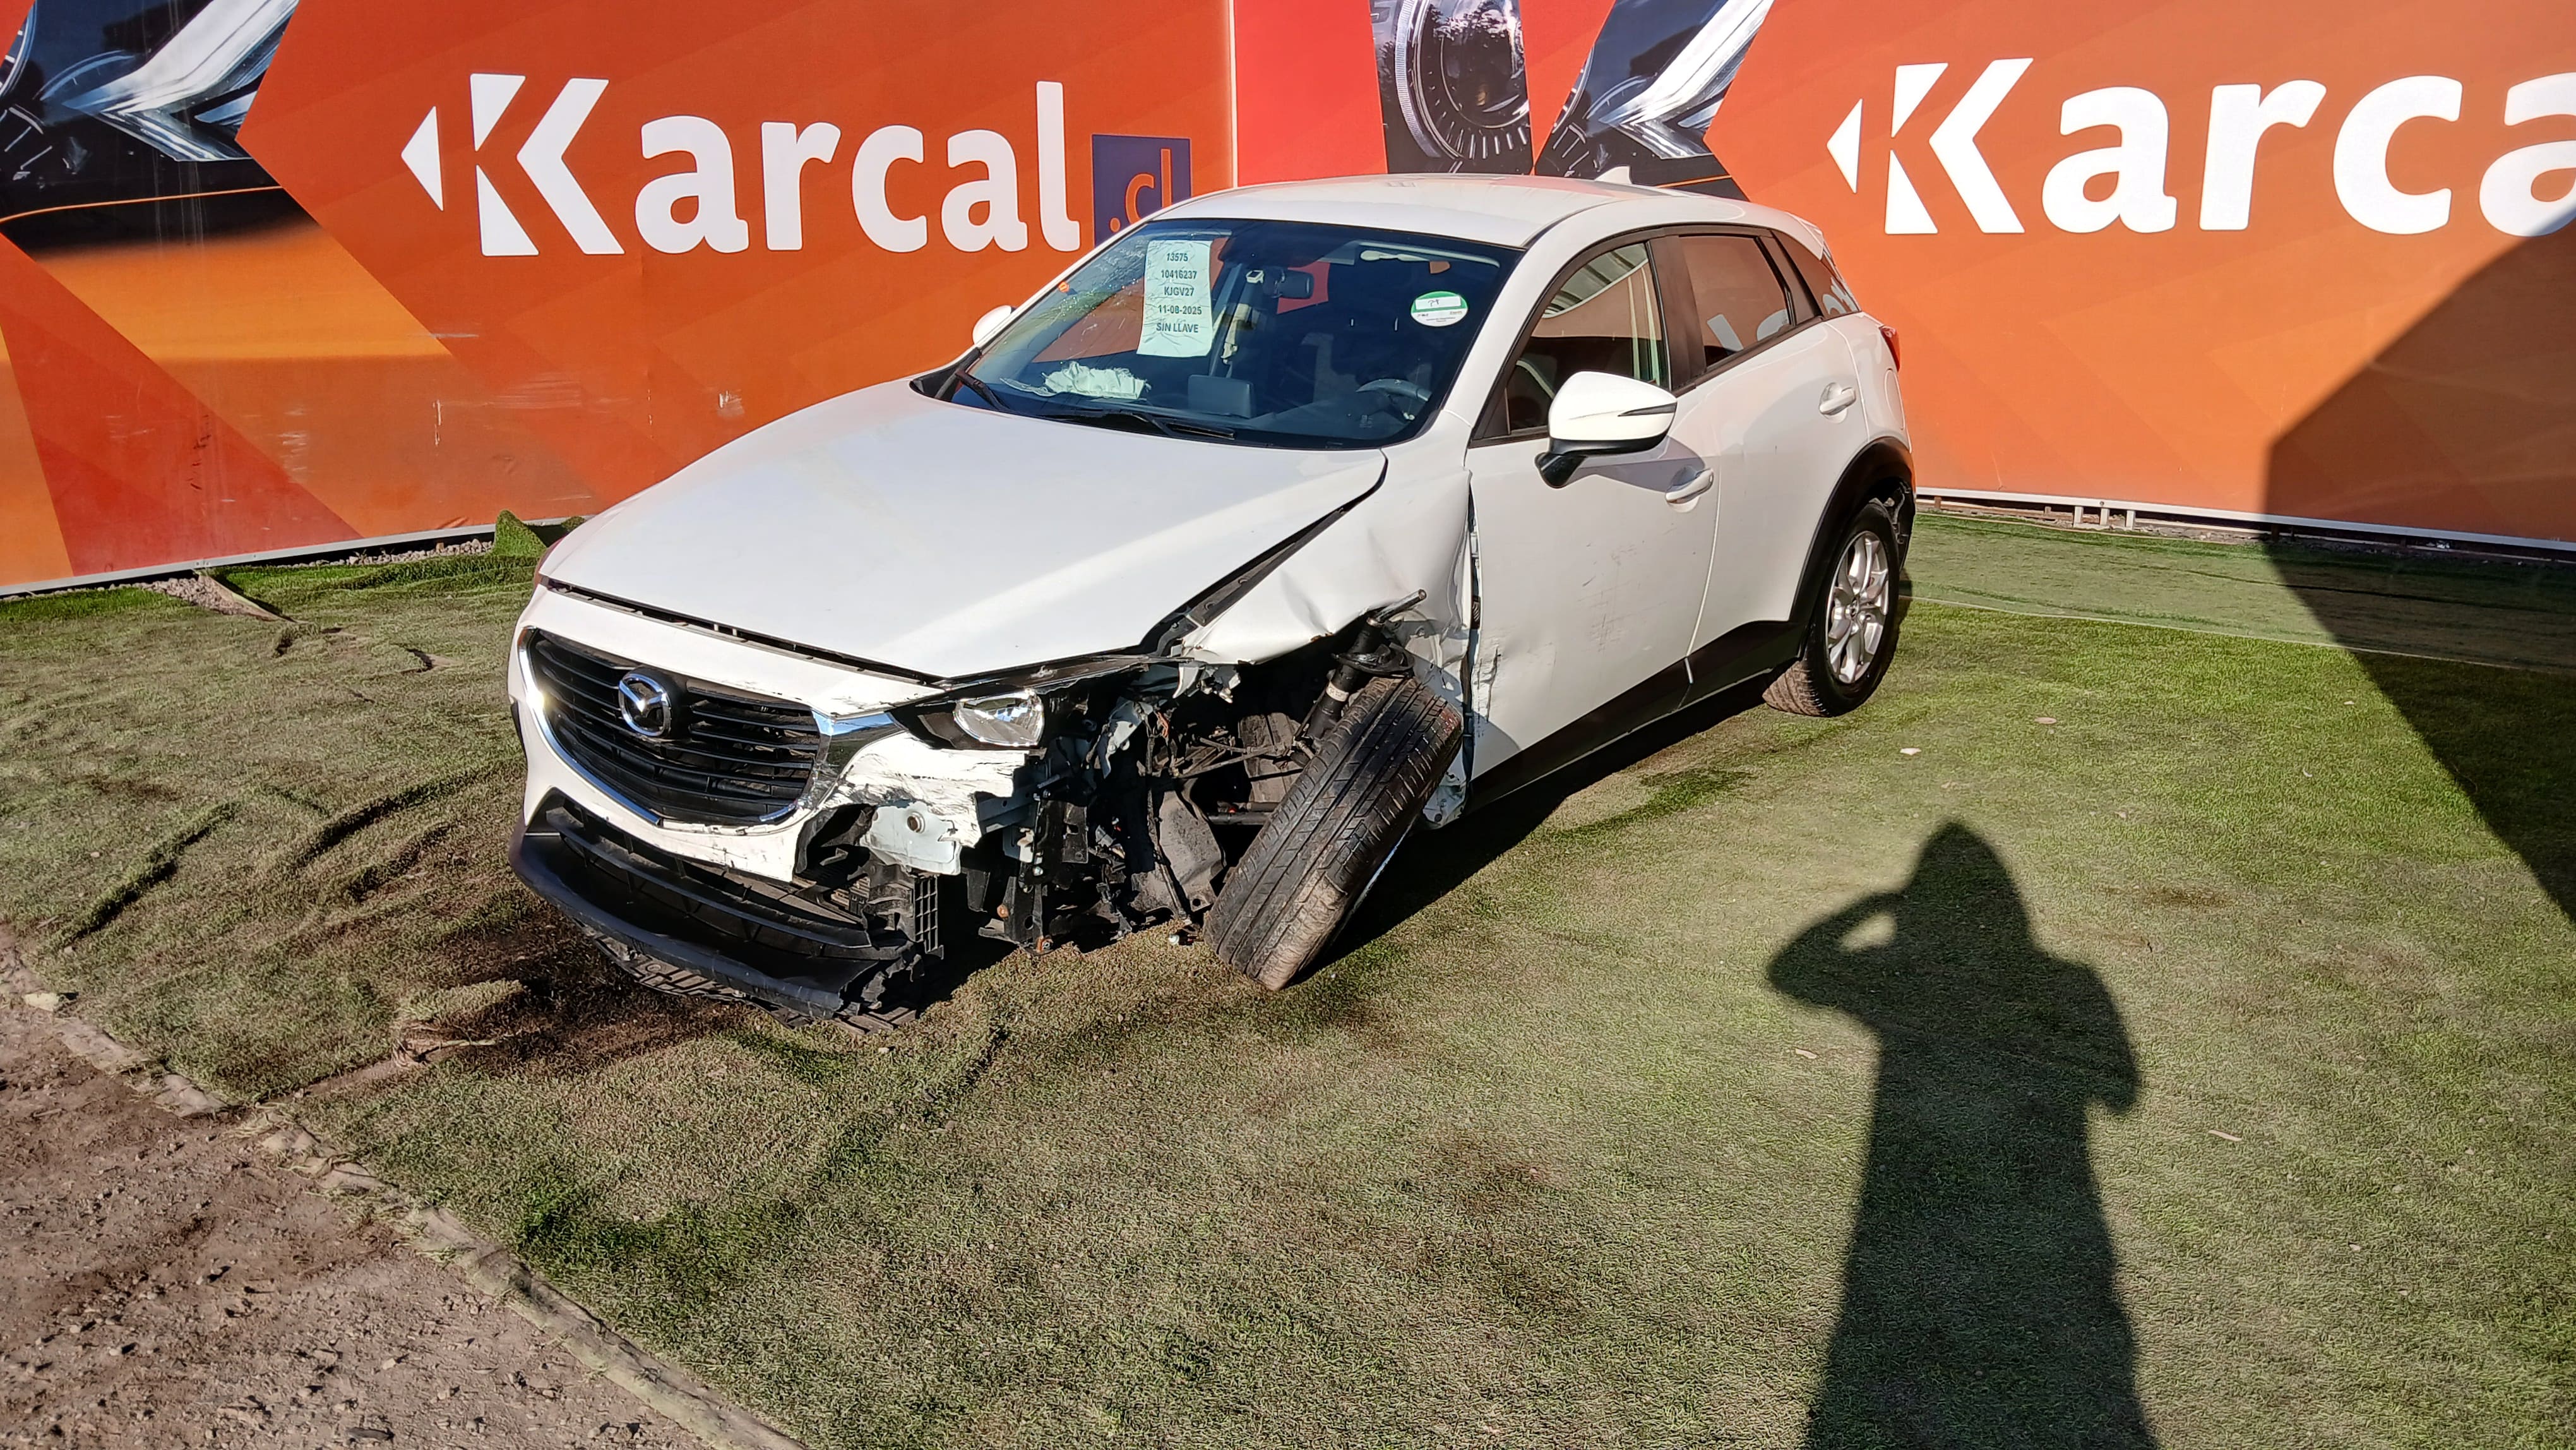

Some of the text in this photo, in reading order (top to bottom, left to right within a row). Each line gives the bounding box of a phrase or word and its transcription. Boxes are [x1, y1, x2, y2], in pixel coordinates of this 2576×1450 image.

[470, 73, 1081, 255] Karcal
[1167, 253, 1188, 262] 13575
[1160, 270, 1197, 279] 10416237
[1164, 287, 1195, 297] KJGV27
[1158, 305, 1202, 315] 11-08-2025
[1156, 322, 1198, 333] SIN LLAVE
